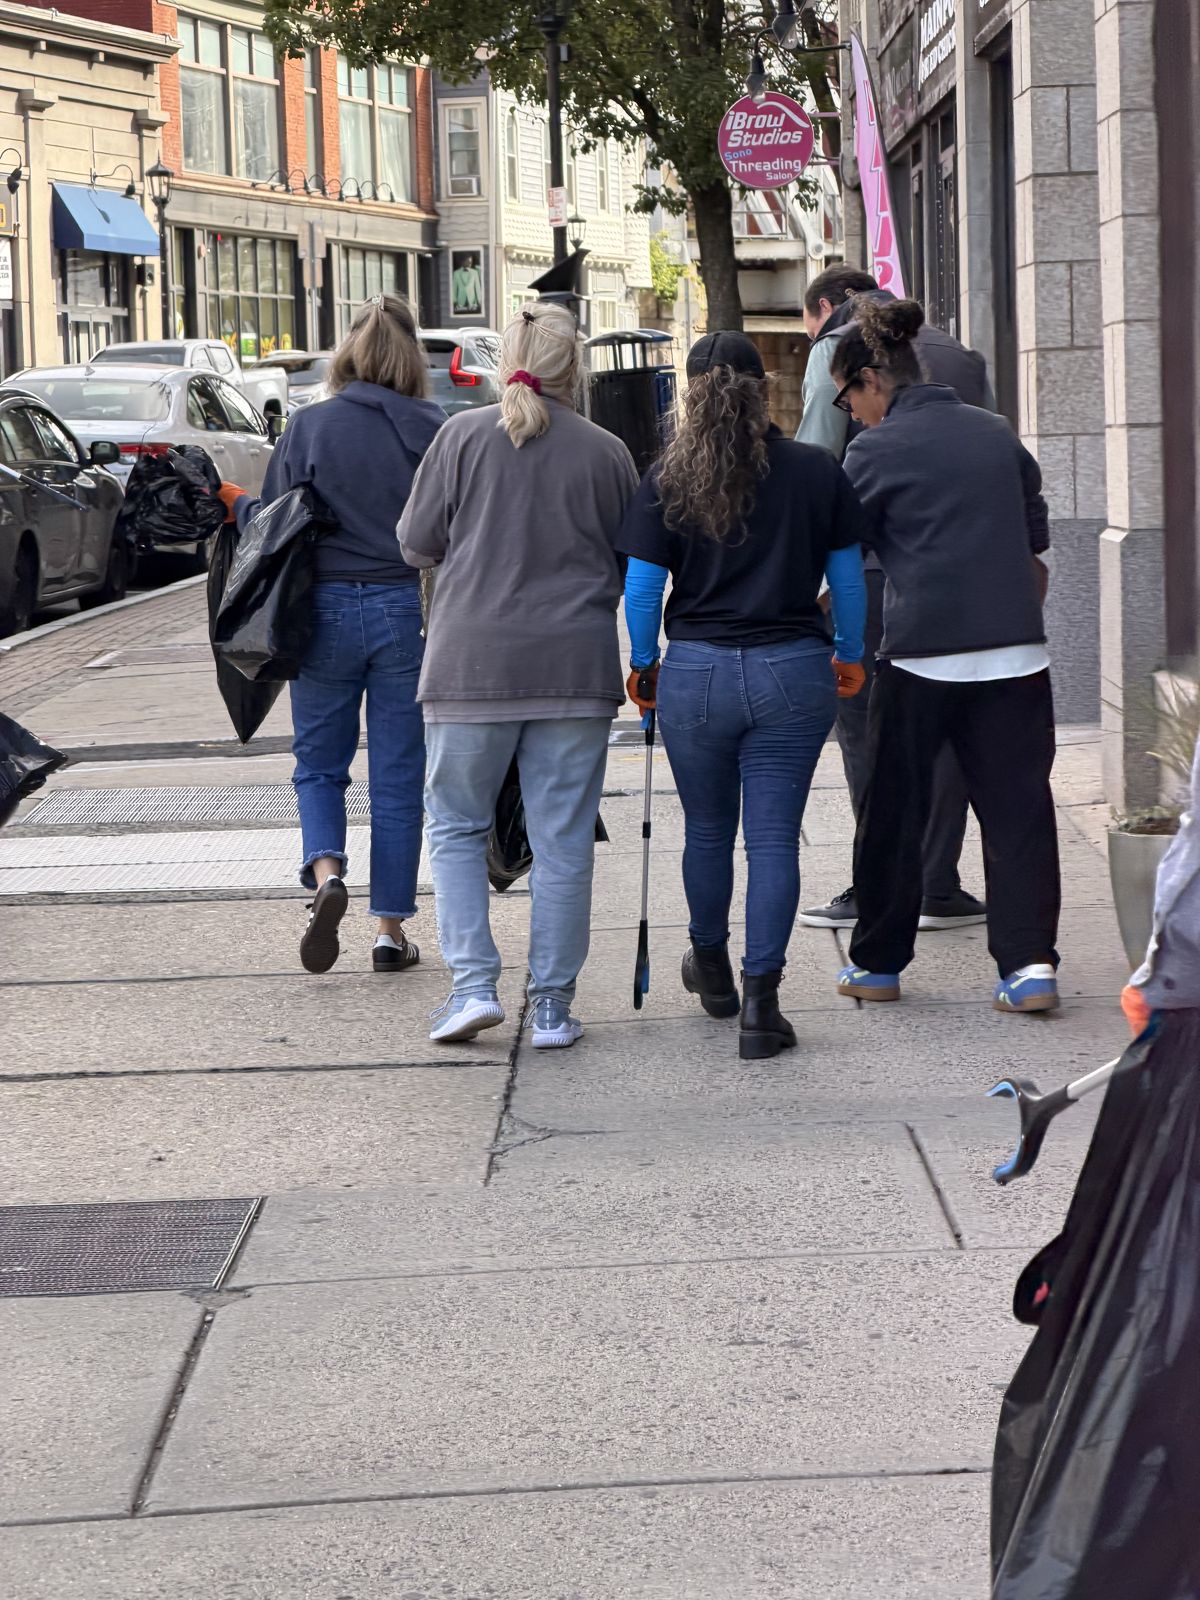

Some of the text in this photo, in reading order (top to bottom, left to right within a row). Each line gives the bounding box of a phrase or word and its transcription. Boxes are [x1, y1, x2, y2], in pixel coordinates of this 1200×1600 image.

[725, 110, 785, 130] iBrow
[727, 129, 803, 147] Studios
[729, 158, 801, 173] Threading
[766, 172, 793, 180] Salon
